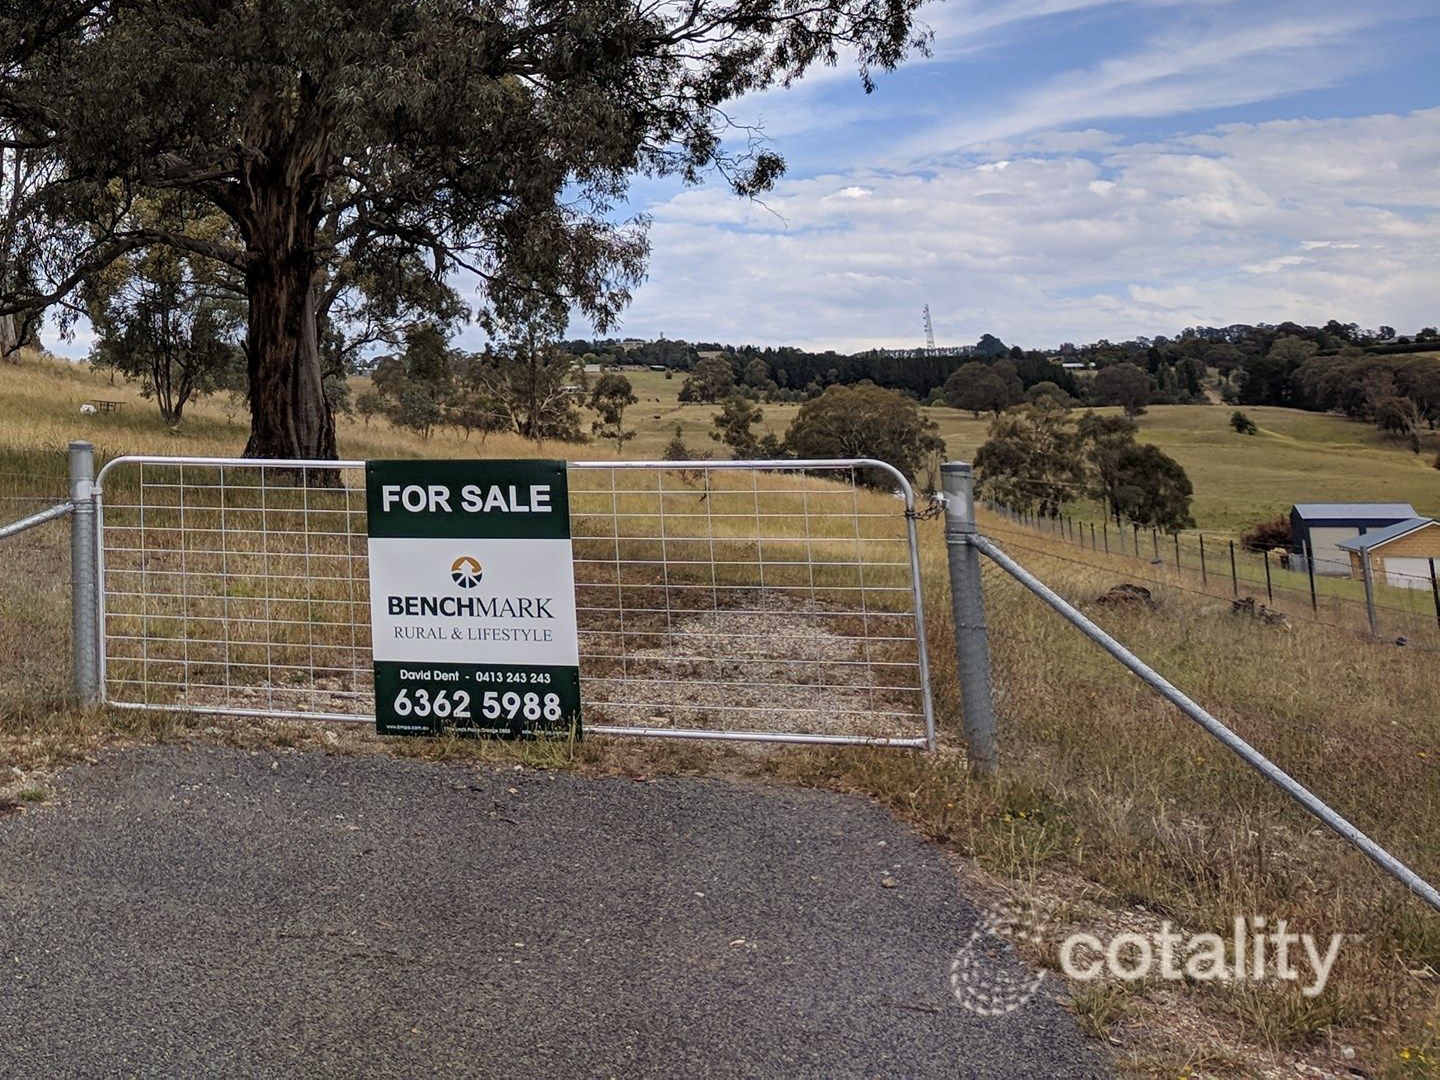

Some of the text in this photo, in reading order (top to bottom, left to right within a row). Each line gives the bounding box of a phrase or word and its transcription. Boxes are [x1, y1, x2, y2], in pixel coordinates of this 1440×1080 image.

[382, 485, 552, 513] FOR SALE
[387, 596, 555, 619] BENCHMARK
[394, 626, 553, 642] RURAL & LIFESTYLE
[400, 669, 431, 681] David
[433, 670, 460, 682] Dent
[475, 671, 503, 683] 0413
[506, 672, 527, 683] 243
[530, 672, 551, 684] 243
[394, 688, 561, 721] 6362 5988
